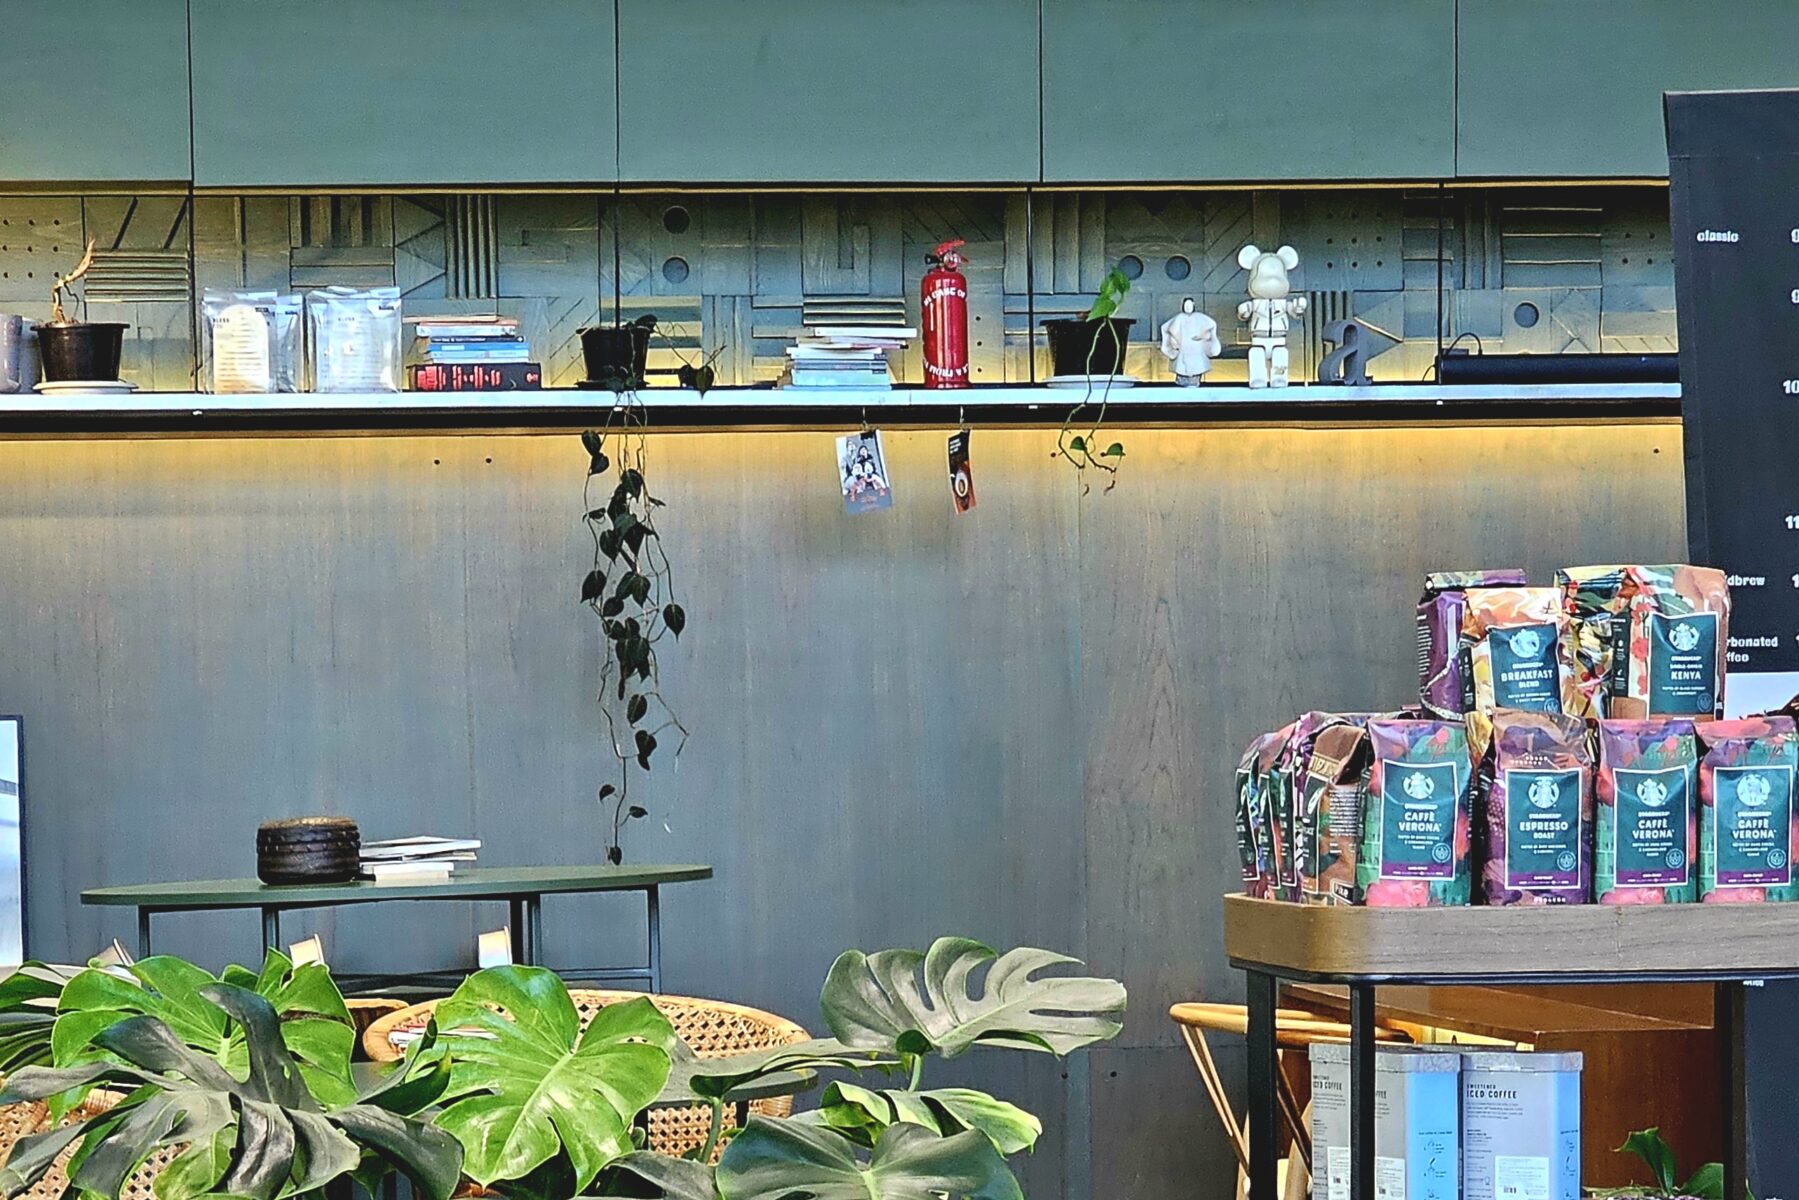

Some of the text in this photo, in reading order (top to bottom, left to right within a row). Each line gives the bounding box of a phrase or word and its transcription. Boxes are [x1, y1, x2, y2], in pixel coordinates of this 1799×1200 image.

[1696, 229, 1739, 243] classic
[1726, 573, 1766, 587] dbrew
[1726, 636, 1779, 648] rbonated
[1501, 669, 1553, 682] BREAKFAST
[1671, 671, 1702, 680] KENYA
[1404, 811, 1435, 822] CAFFÈ
[1398, 821, 1441, 832] VERONA
[1520, 821, 1569, 831] ESPRESSO
[1638, 818, 1668, 829] CAFFÈ
[1738, 818, 1769, 829] CAFFÈ
[1632, 829, 1673, 839] VERONA
[1732, 829, 1775, 839] VERONA
[1466, 1090, 1517, 1099] ICED COFFEE
